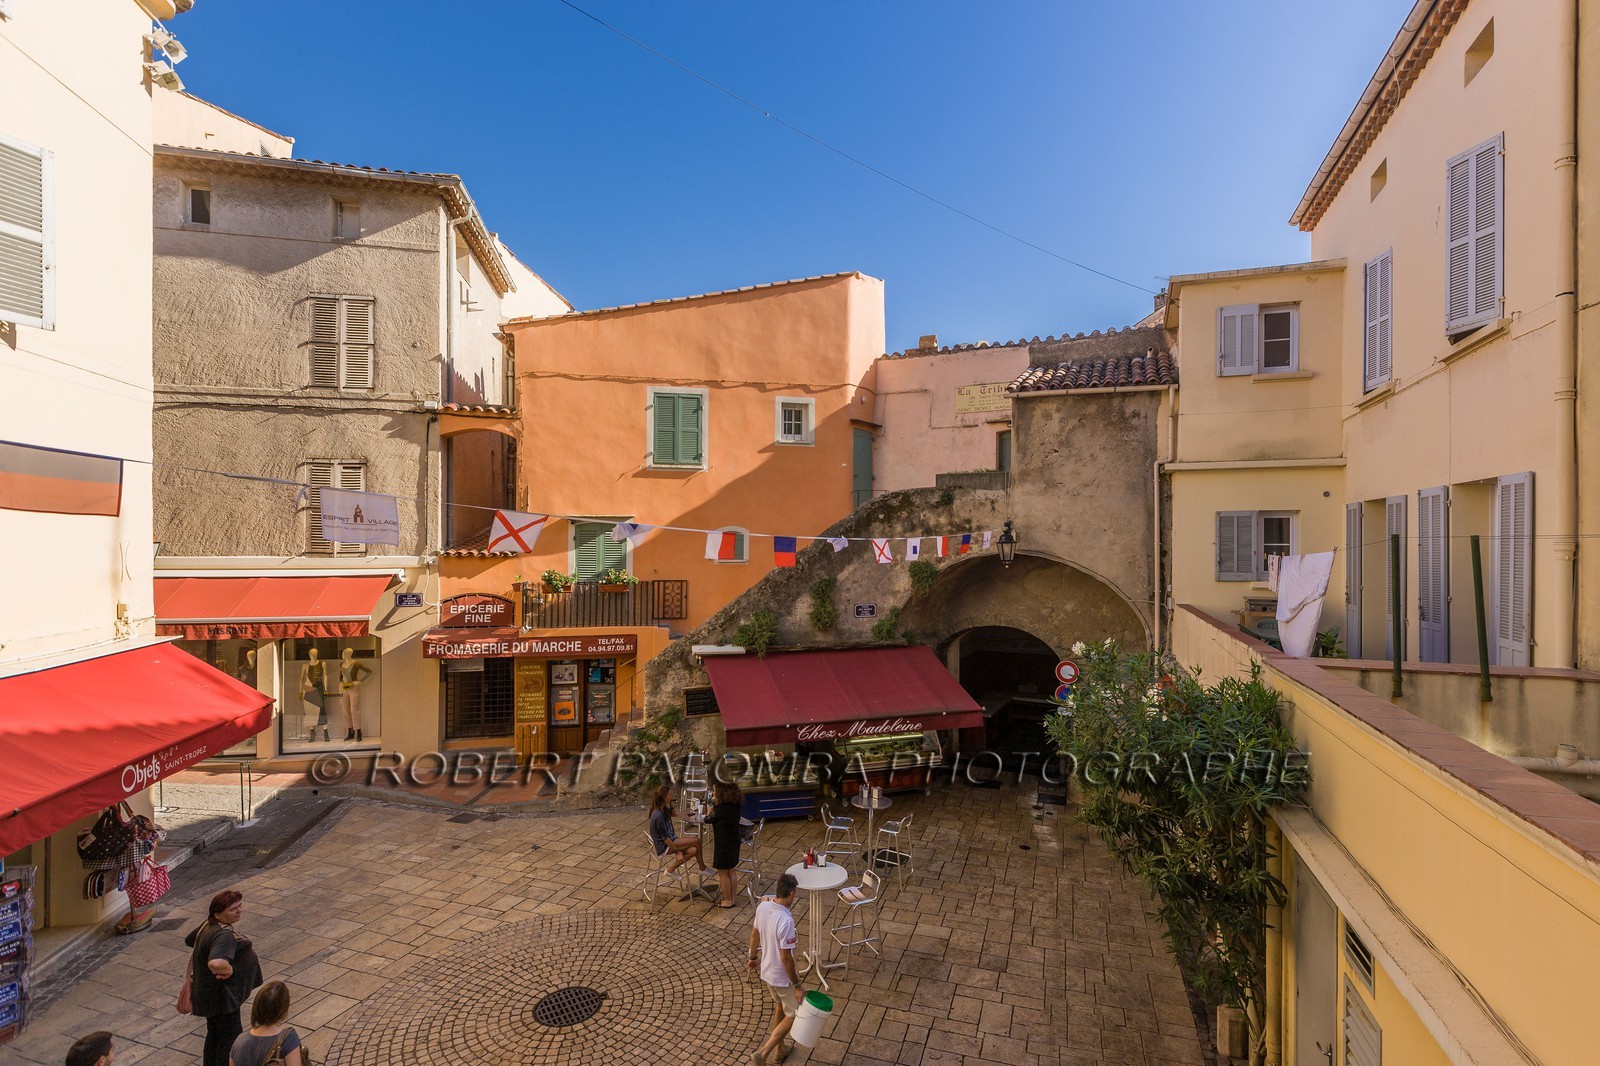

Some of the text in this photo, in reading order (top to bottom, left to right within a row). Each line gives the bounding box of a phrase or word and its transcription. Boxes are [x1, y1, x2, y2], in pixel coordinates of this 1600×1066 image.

[323, 515, 350, 523] ESPRIT
[450, 604, 505, 614] EPICERIE
[464, 614, 492, 623] FINE
[428, 640, 582, 656] FROMAGERIE DU MARCHE
[587, 644, 634, 653] 04.94.97.09.81
[796, 717, 923, 741] Chez Madeleine
[121, 754, 161, 793] Objets
[164, 745, 207, 771] SAINT-TROPEZ
